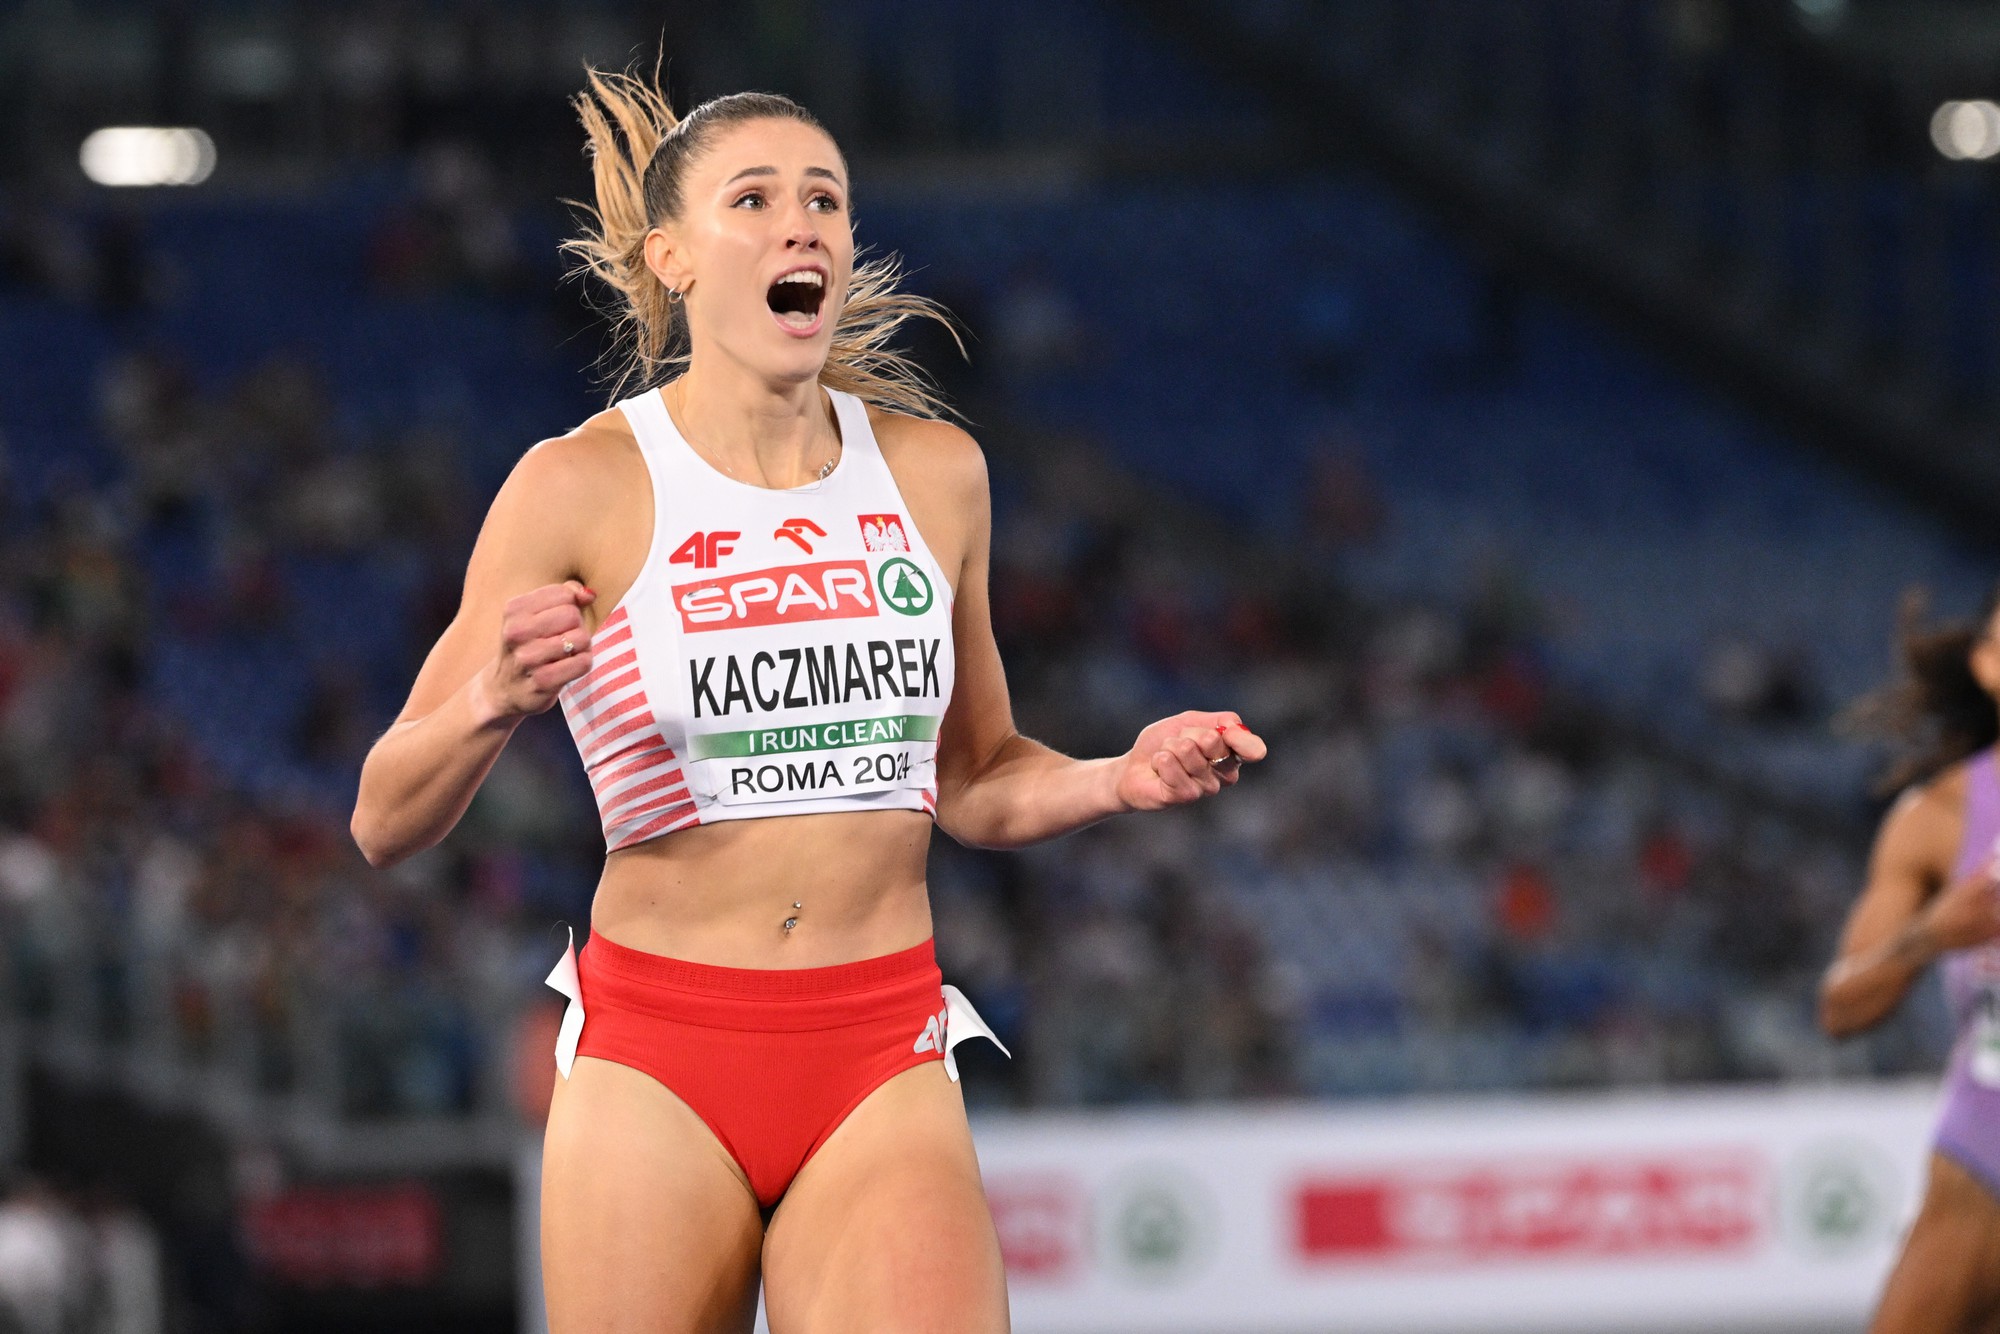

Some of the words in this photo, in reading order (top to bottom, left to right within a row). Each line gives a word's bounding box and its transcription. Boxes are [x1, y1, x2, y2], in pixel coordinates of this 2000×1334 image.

[669, 531, 741, 569] 4F
[681, 568, 871, 623] SPAR
[690, 639, 941, 718] KACZMAREK
[749, 733, 755, 753] I
[762, 727, 818, 752] RUN
[731, 760, 844, 795] ROMA
[853, 751, 909, 785] 2024
